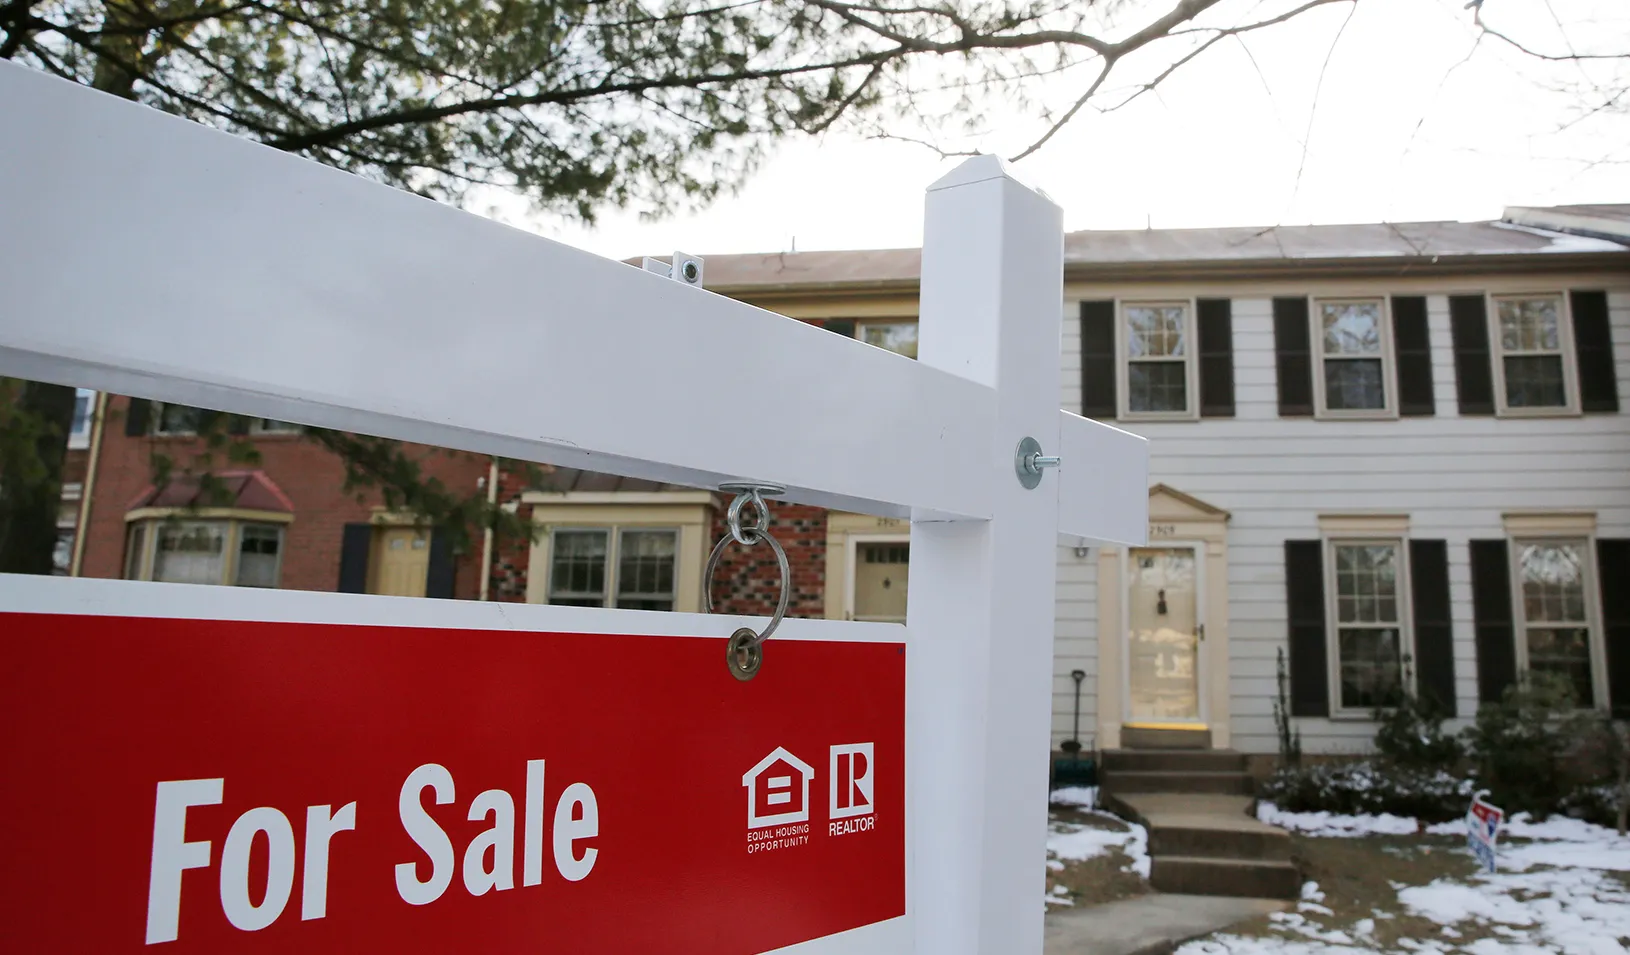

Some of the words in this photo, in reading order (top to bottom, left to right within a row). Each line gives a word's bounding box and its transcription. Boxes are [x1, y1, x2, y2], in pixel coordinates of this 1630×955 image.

[747, 830, 774, 842] EQUAL
[775, 824, 810, 838] HOUSING
[145, 777, 357, 945] For
[395, 759, 599, 905] Sale
[747, 835, 809, 854] OPPORTUNITY
